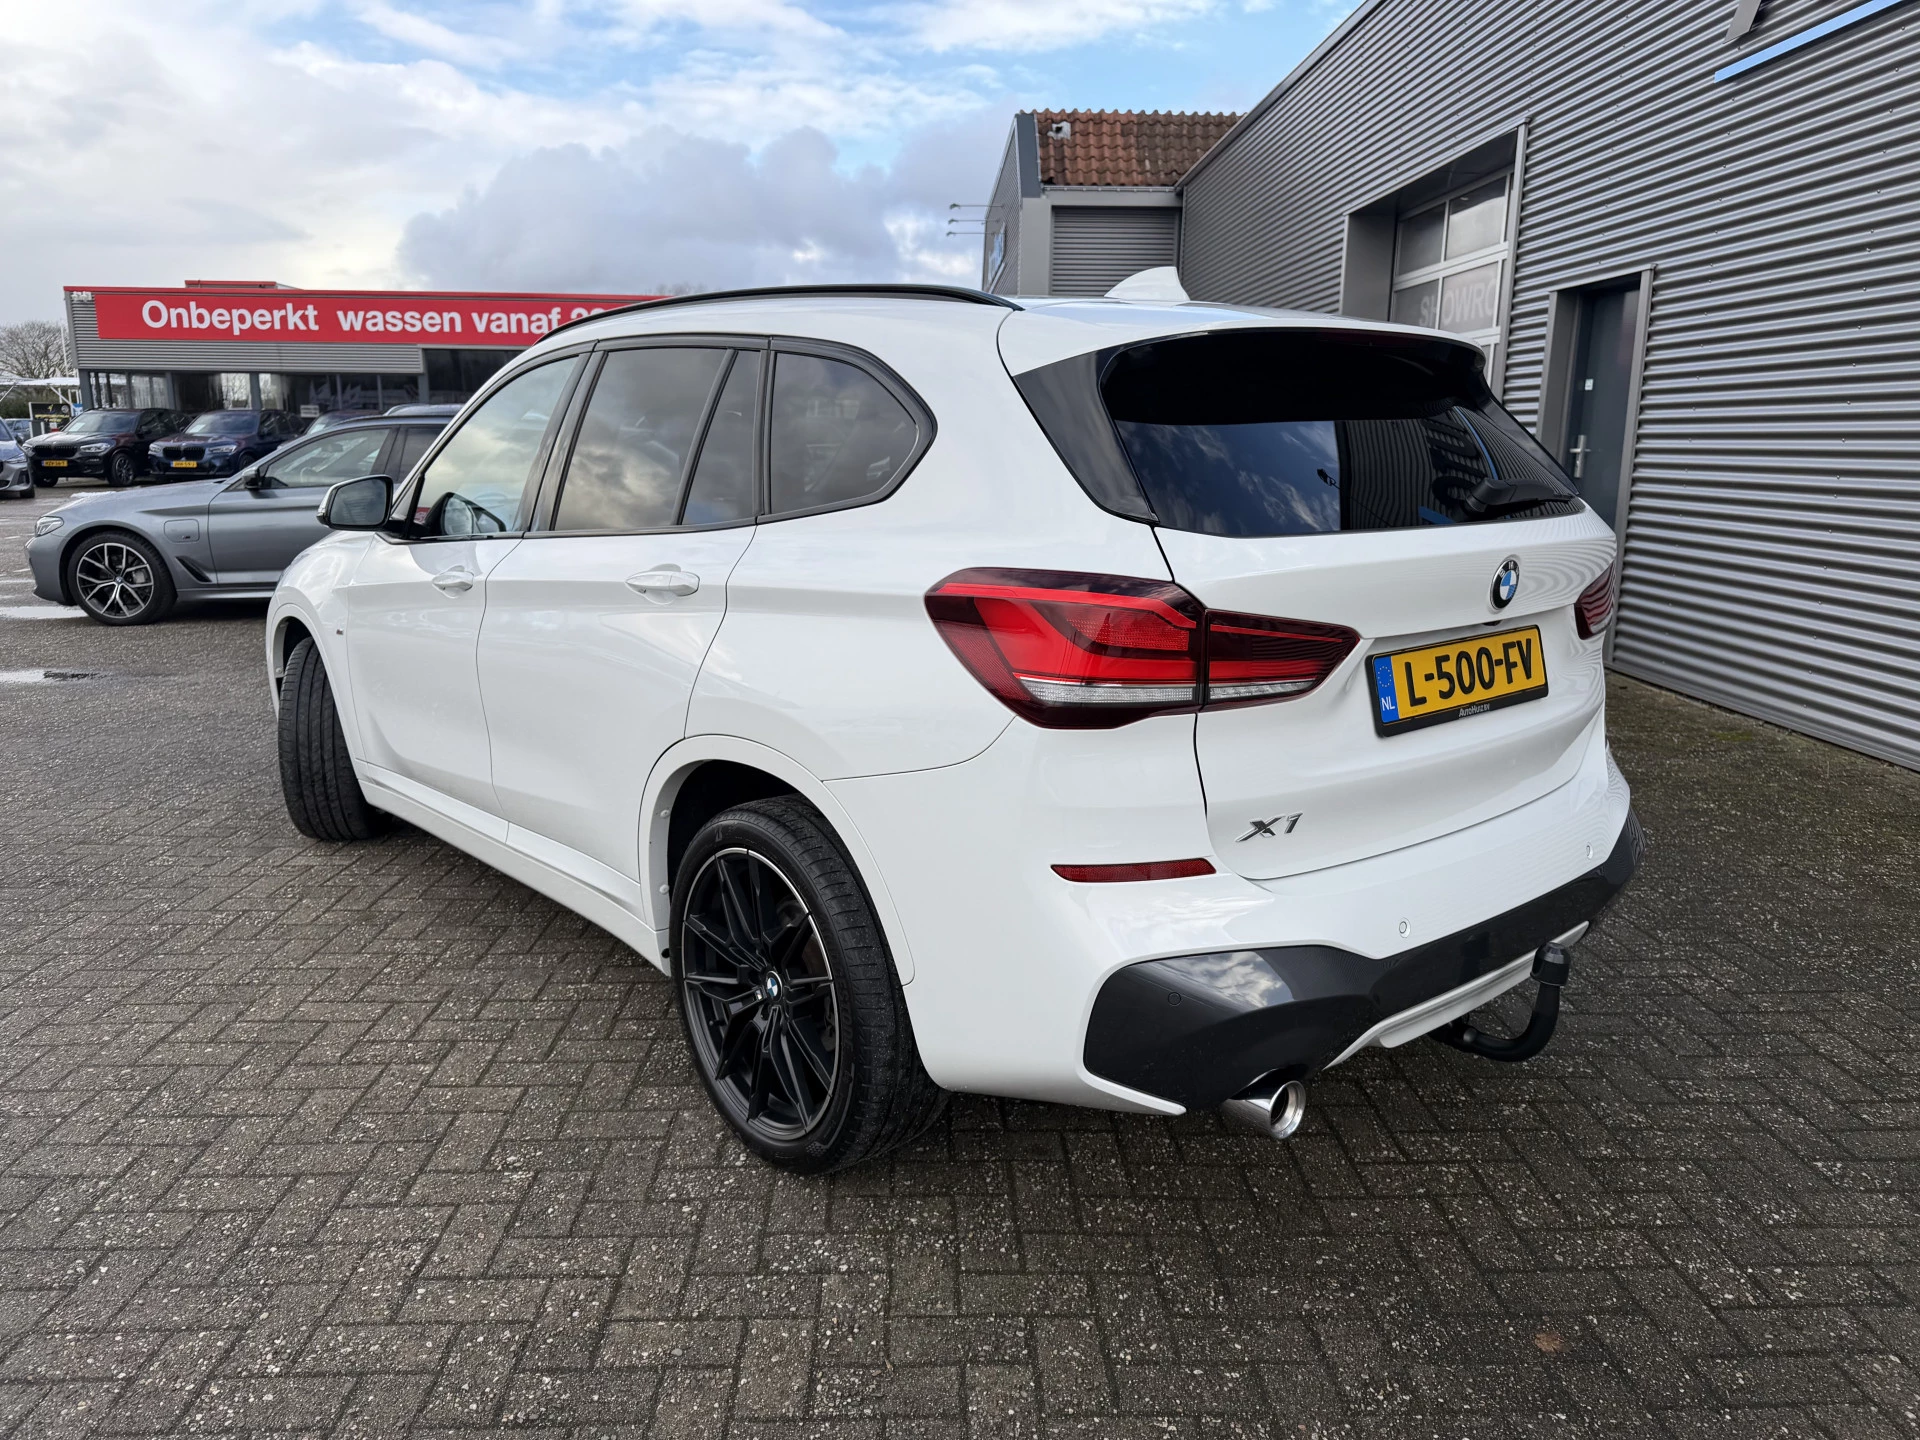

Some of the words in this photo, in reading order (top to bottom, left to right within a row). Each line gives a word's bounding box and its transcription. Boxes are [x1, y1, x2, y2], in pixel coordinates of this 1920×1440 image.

[142, 300, 319, 335] Onbeperkt
[337, 310, 462, 333] wassen
[471, 307, 561, 334] vanaf
[1404, 638, 1532, 707] L-500-FV
[1381, 697, 1395, 712] NL
[1234, 811, 1303, 842] X1
